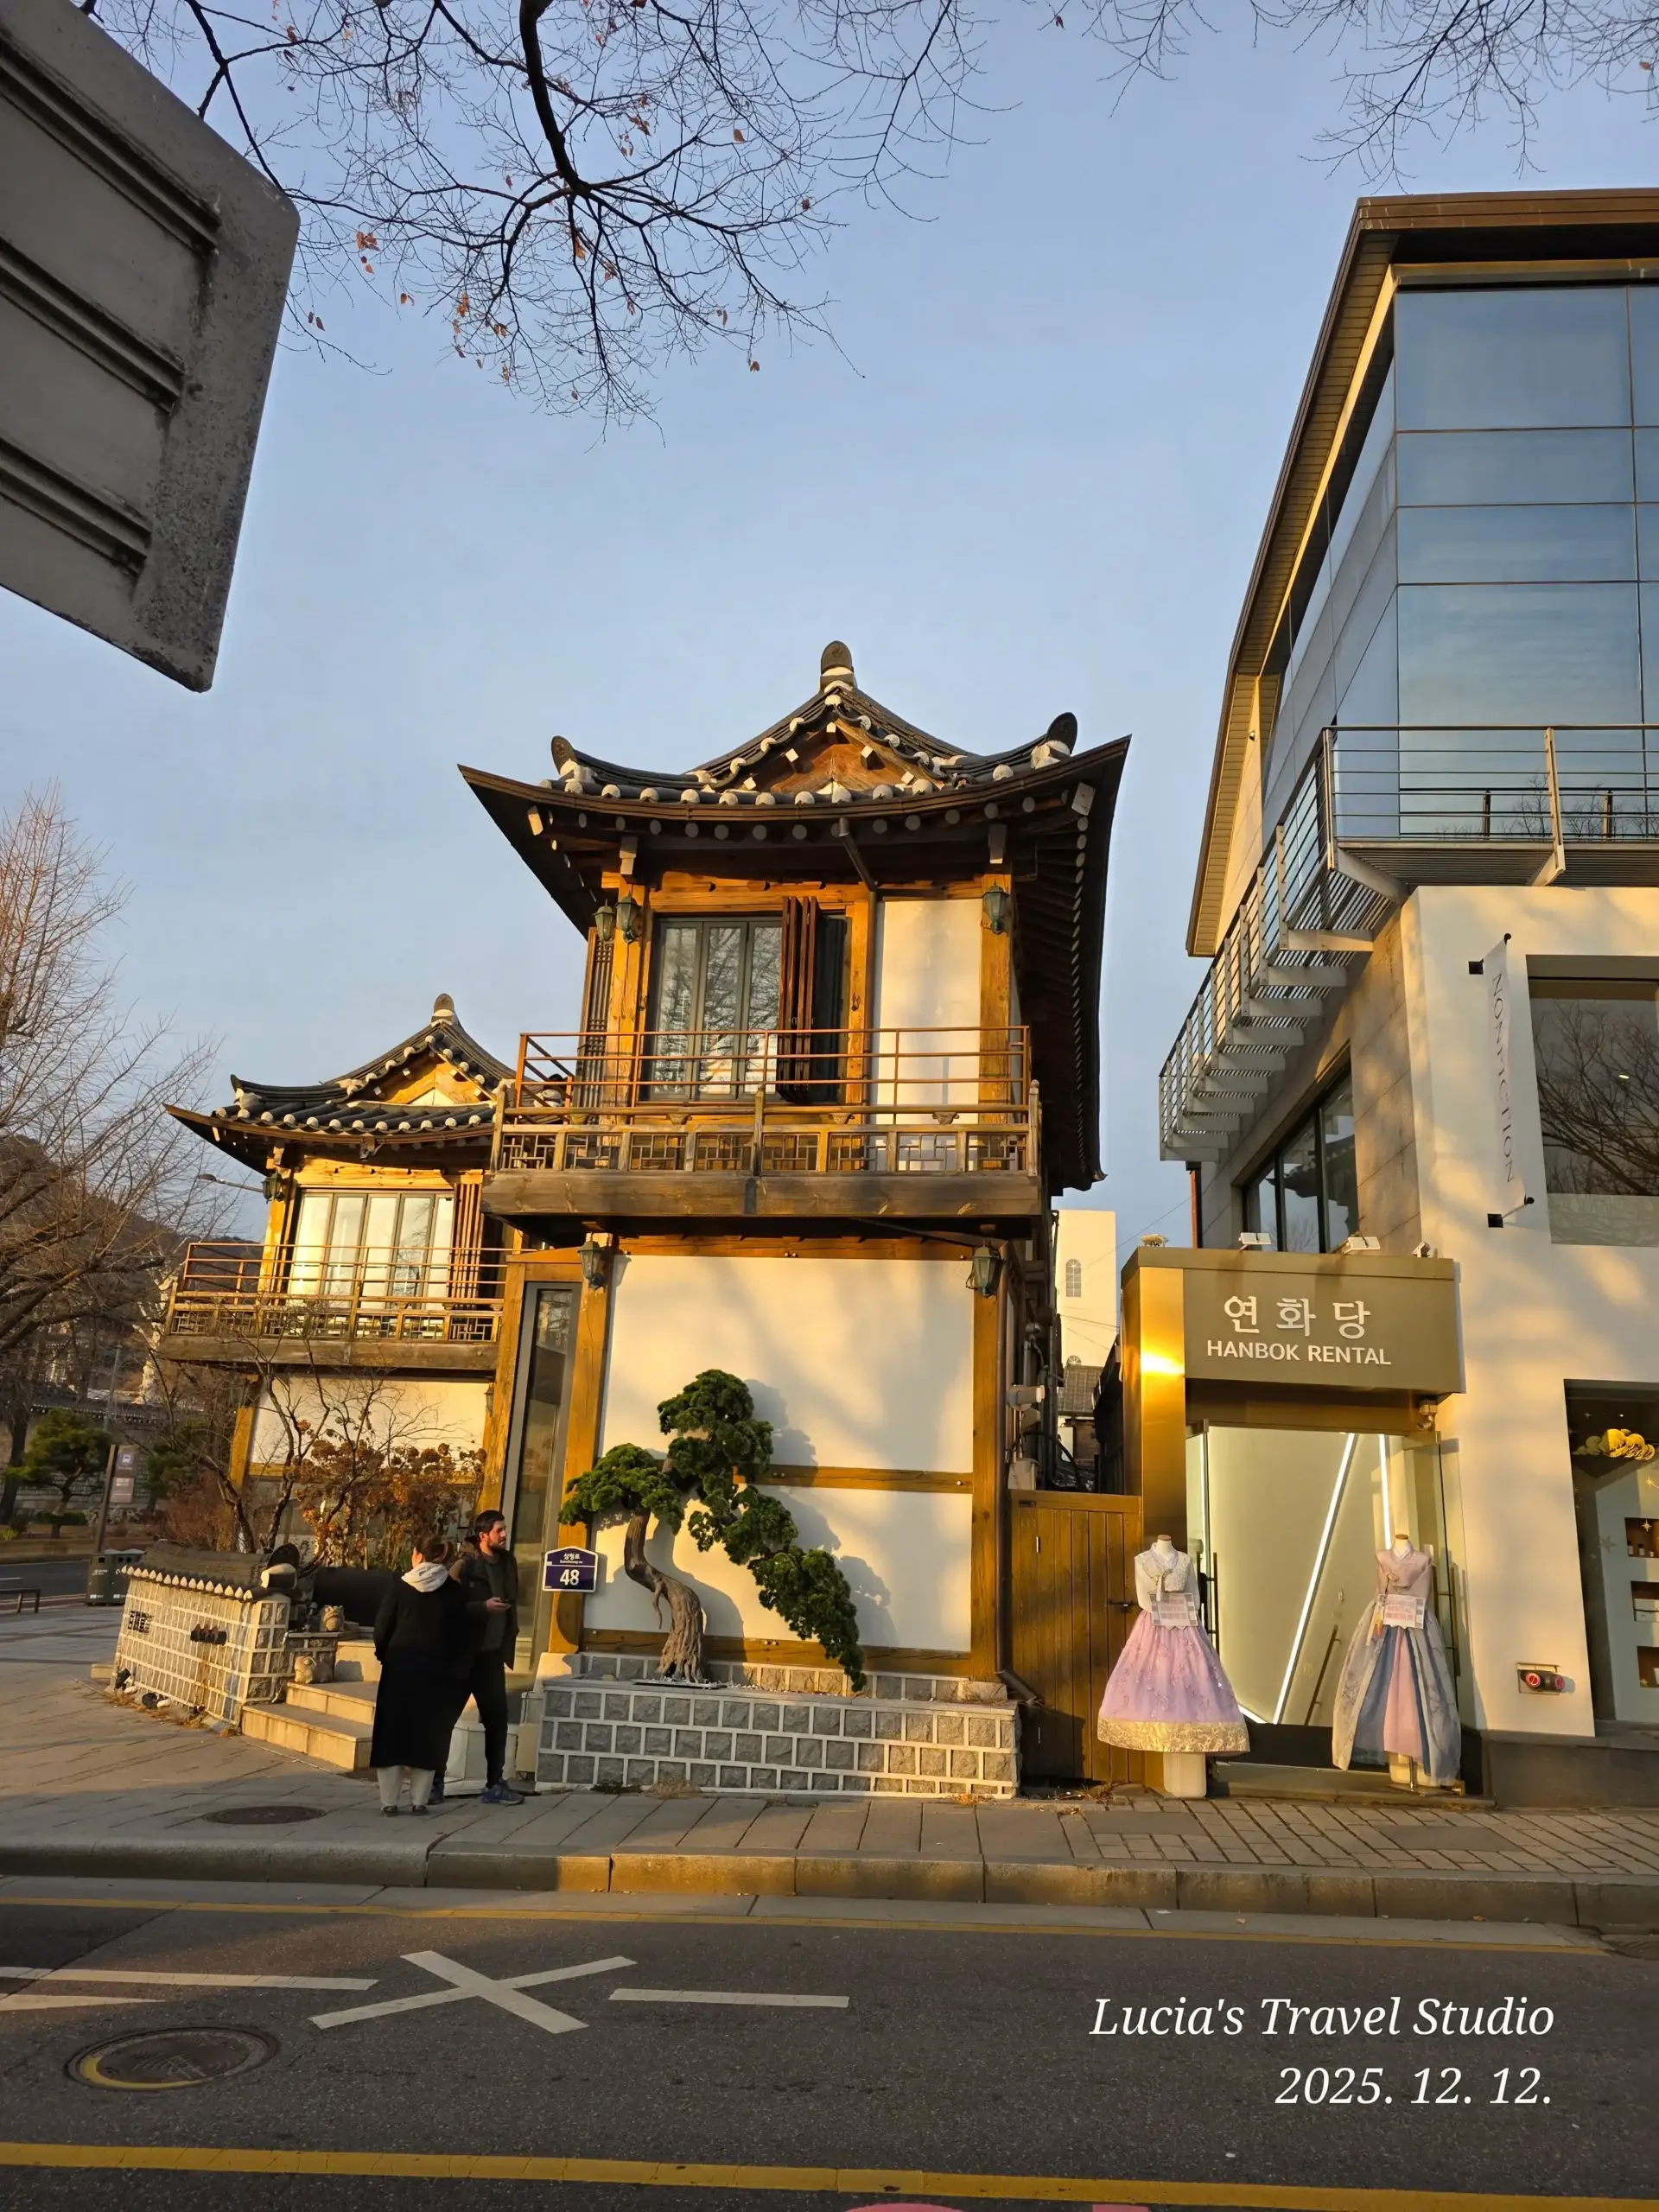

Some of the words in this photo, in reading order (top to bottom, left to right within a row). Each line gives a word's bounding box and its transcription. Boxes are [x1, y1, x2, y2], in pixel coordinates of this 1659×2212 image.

[1207, 1339, 1300, 1361] HANBOK
[1307, 1344, 1392, 1365] RENTAL
[560, 1569, 579, 1585] 48
